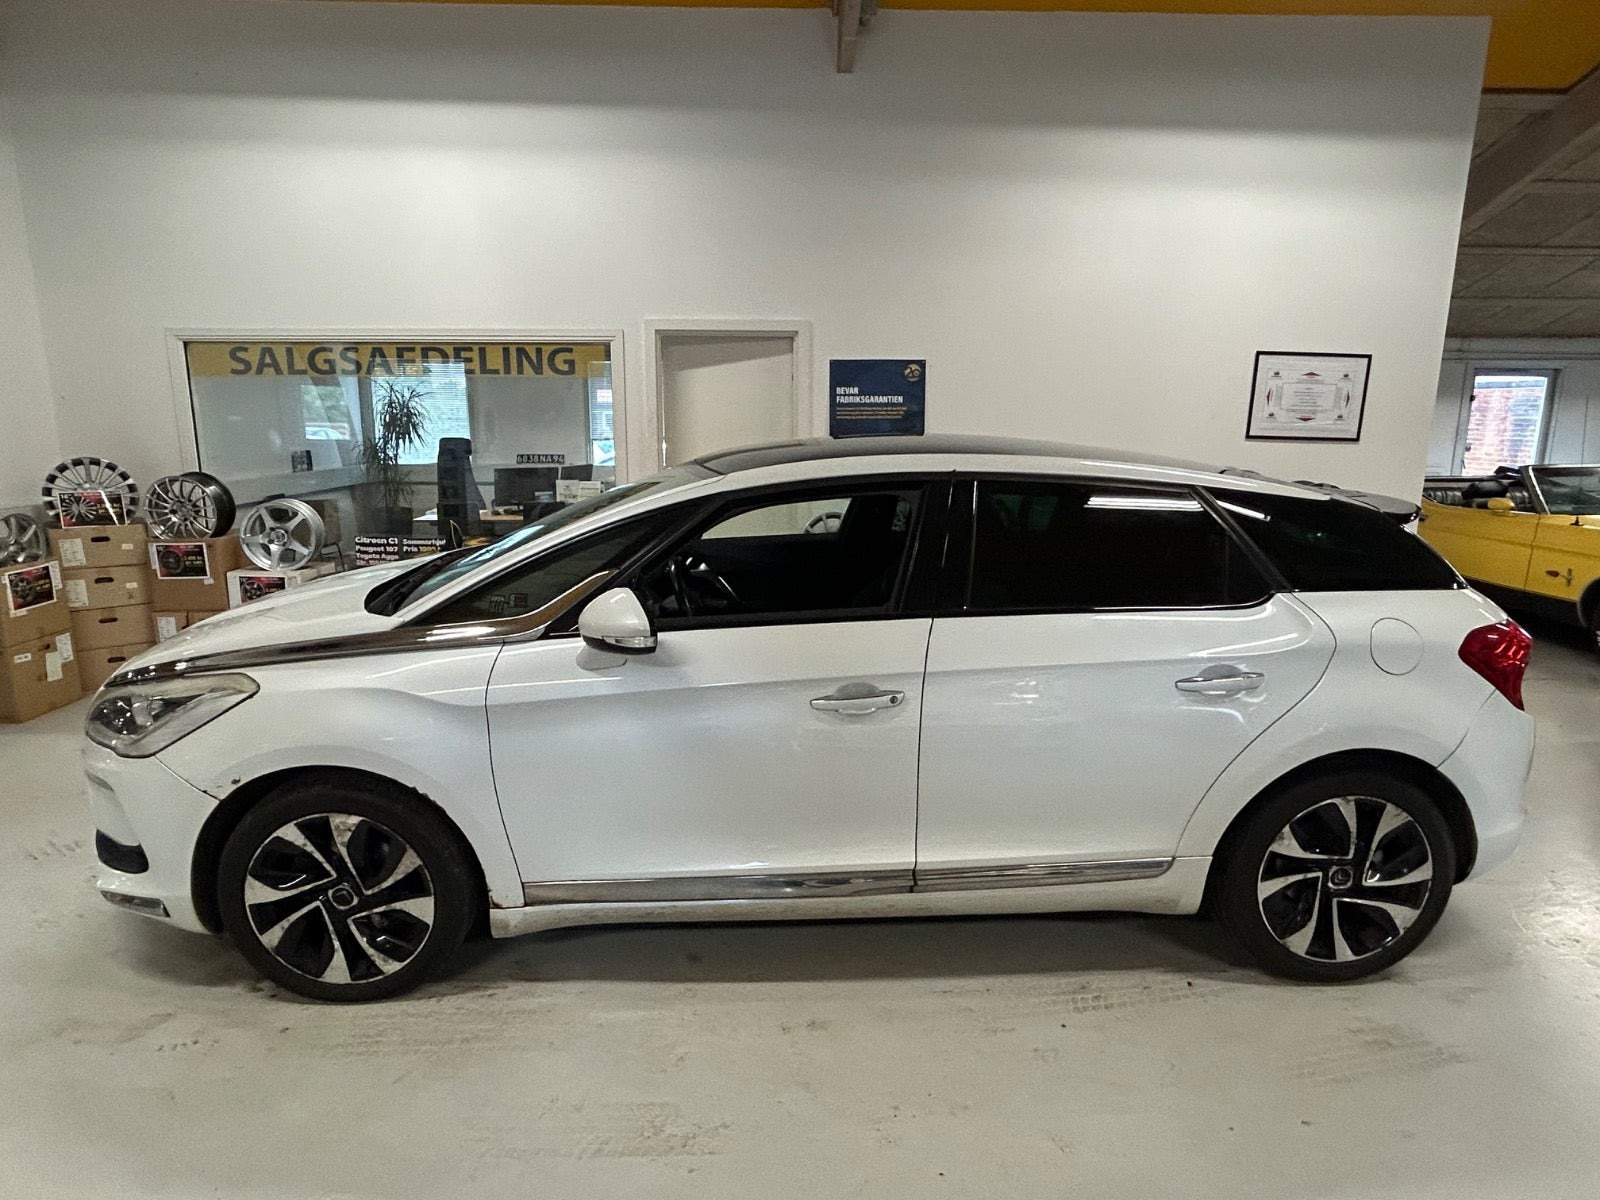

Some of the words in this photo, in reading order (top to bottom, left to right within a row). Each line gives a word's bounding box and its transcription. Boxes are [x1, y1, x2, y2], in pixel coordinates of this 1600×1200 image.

[229, 346, 576, 376] SALGSAFDELING
[836, 387, 859, 395] BEVAR
[836, 395, 904, 404] FABRIKSGARANTIEN
